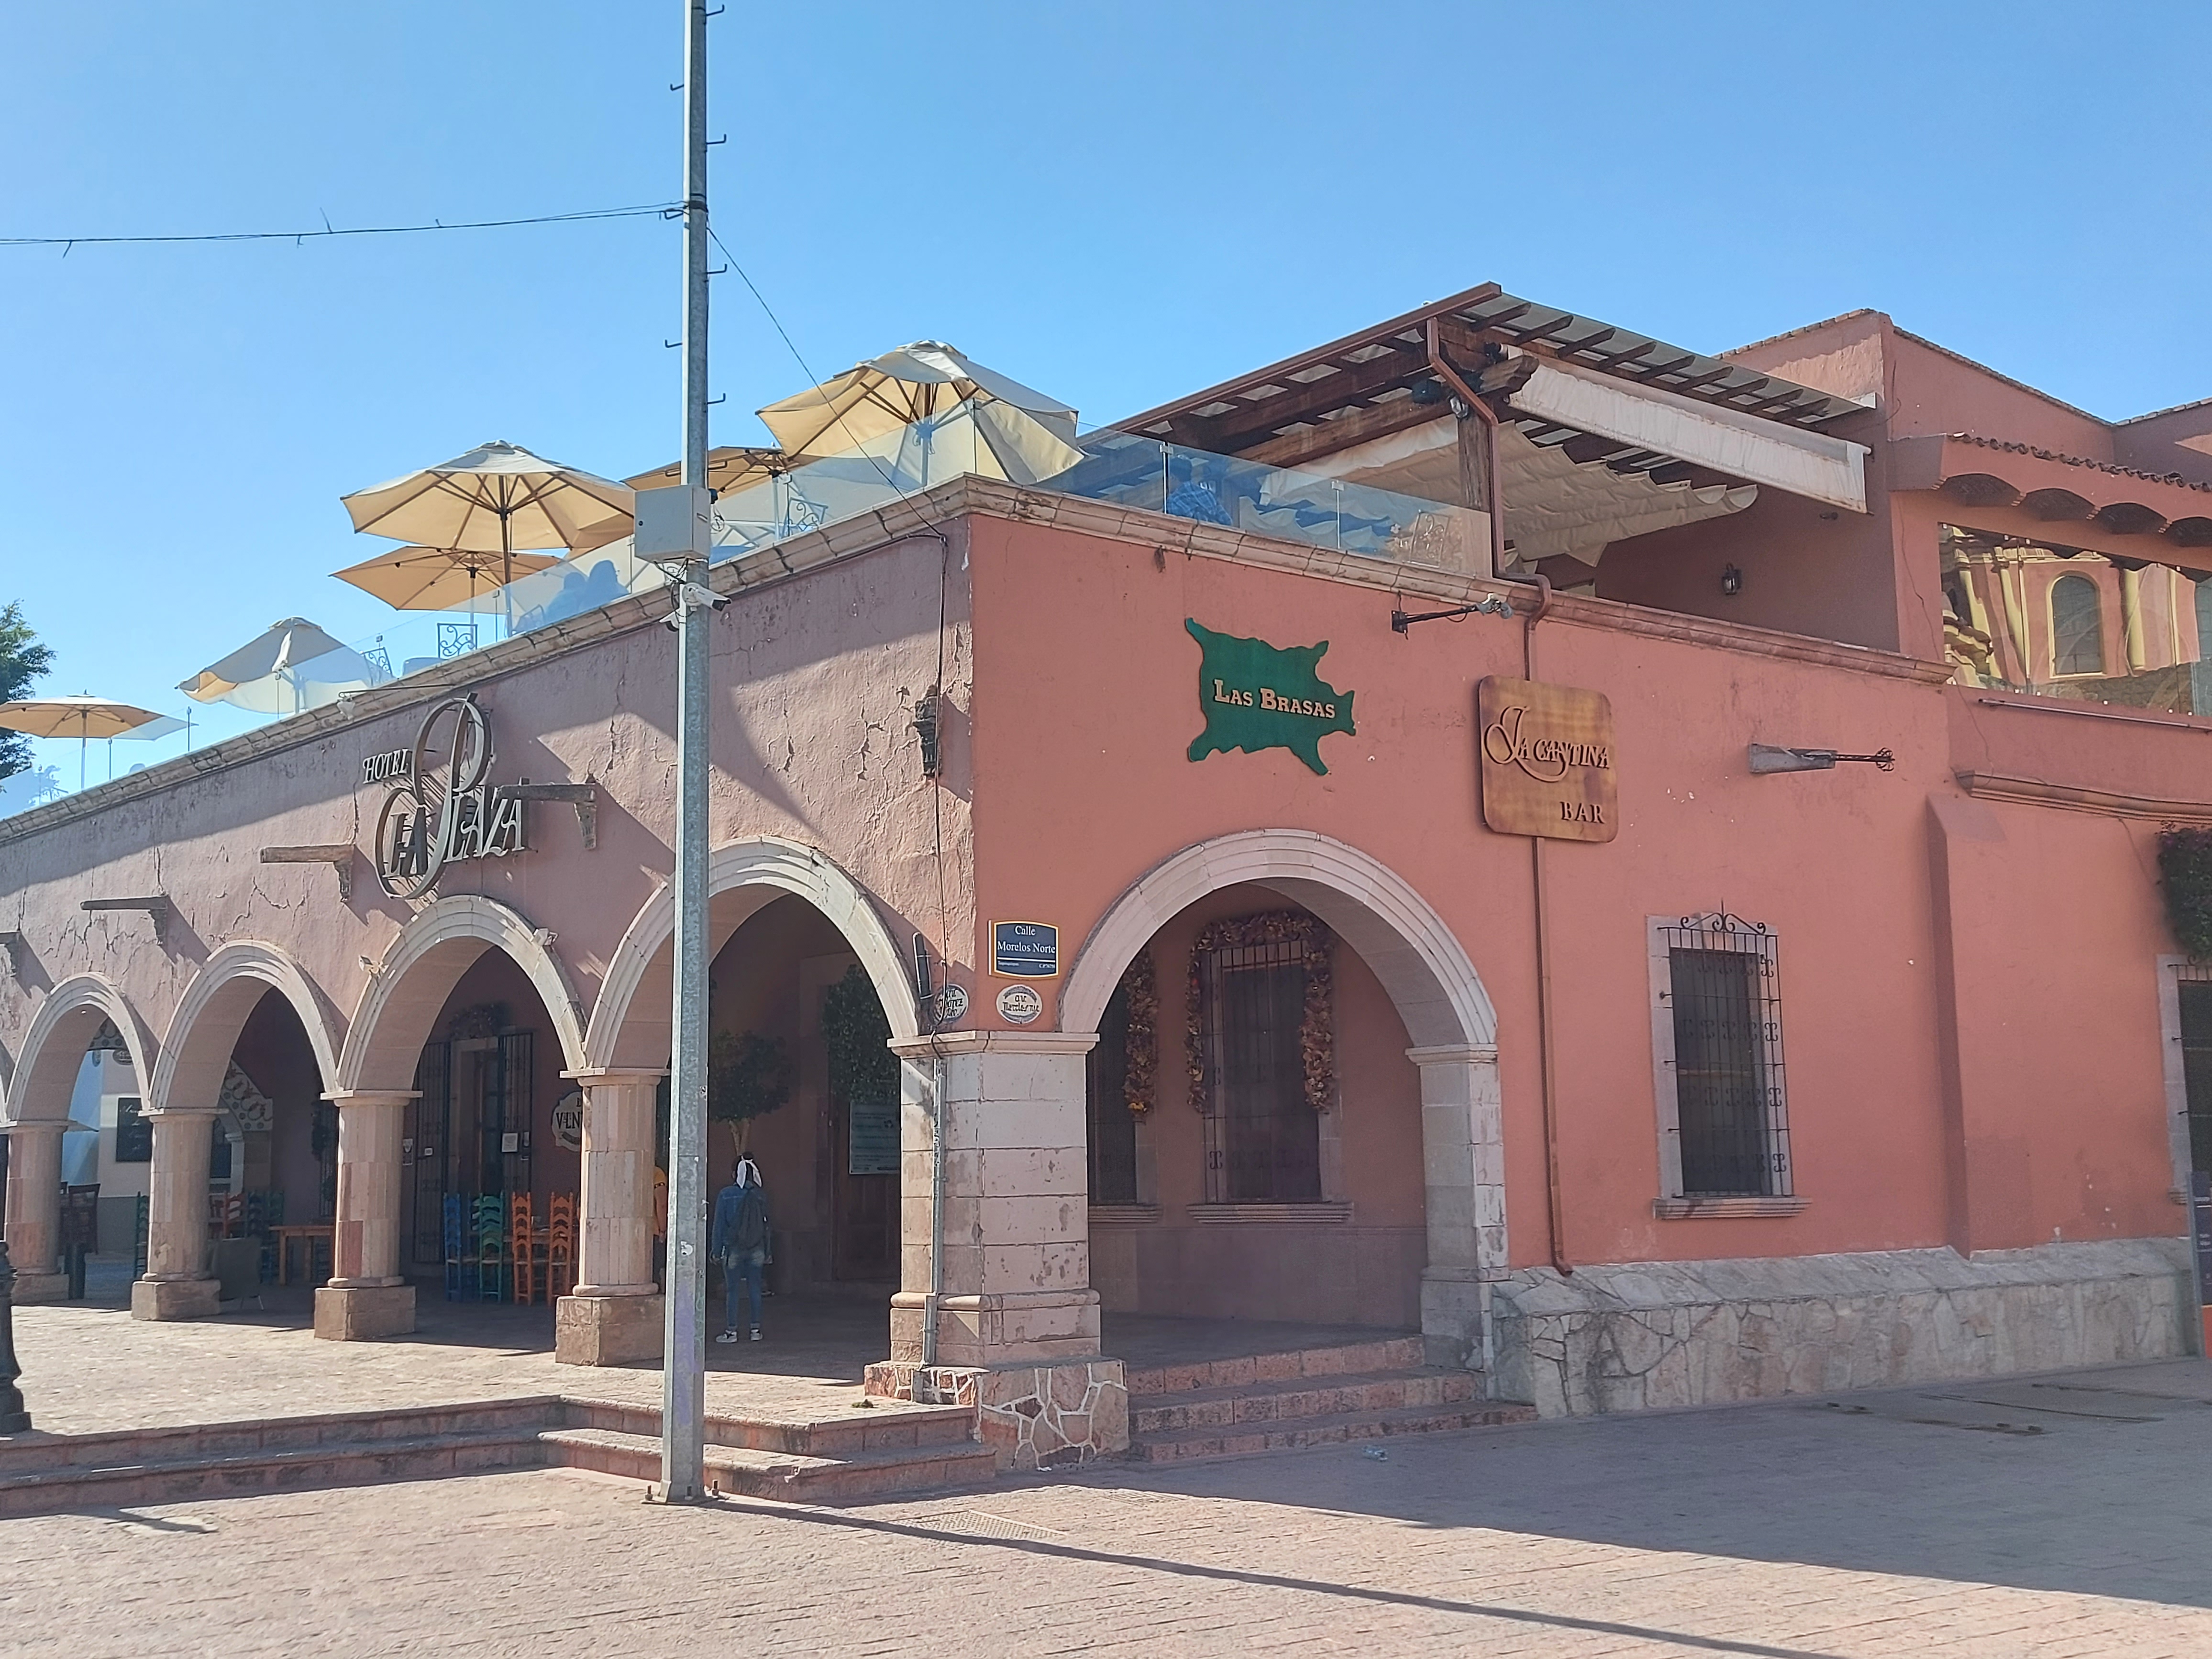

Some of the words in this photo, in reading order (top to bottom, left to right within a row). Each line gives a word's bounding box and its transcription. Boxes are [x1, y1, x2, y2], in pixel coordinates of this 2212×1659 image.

[1214, 679, 1254, 707] LAS
[1260, 687, 1336, 719] BRASAS
[363, 748, 408, 784] HOTEL
[1559, 801, 1605, 824] BAR
[1015, 925, 1036, 936] Calle
[997, 940, 1031, 952] Morelos
[1032, 942, 1056, 954] Norte
